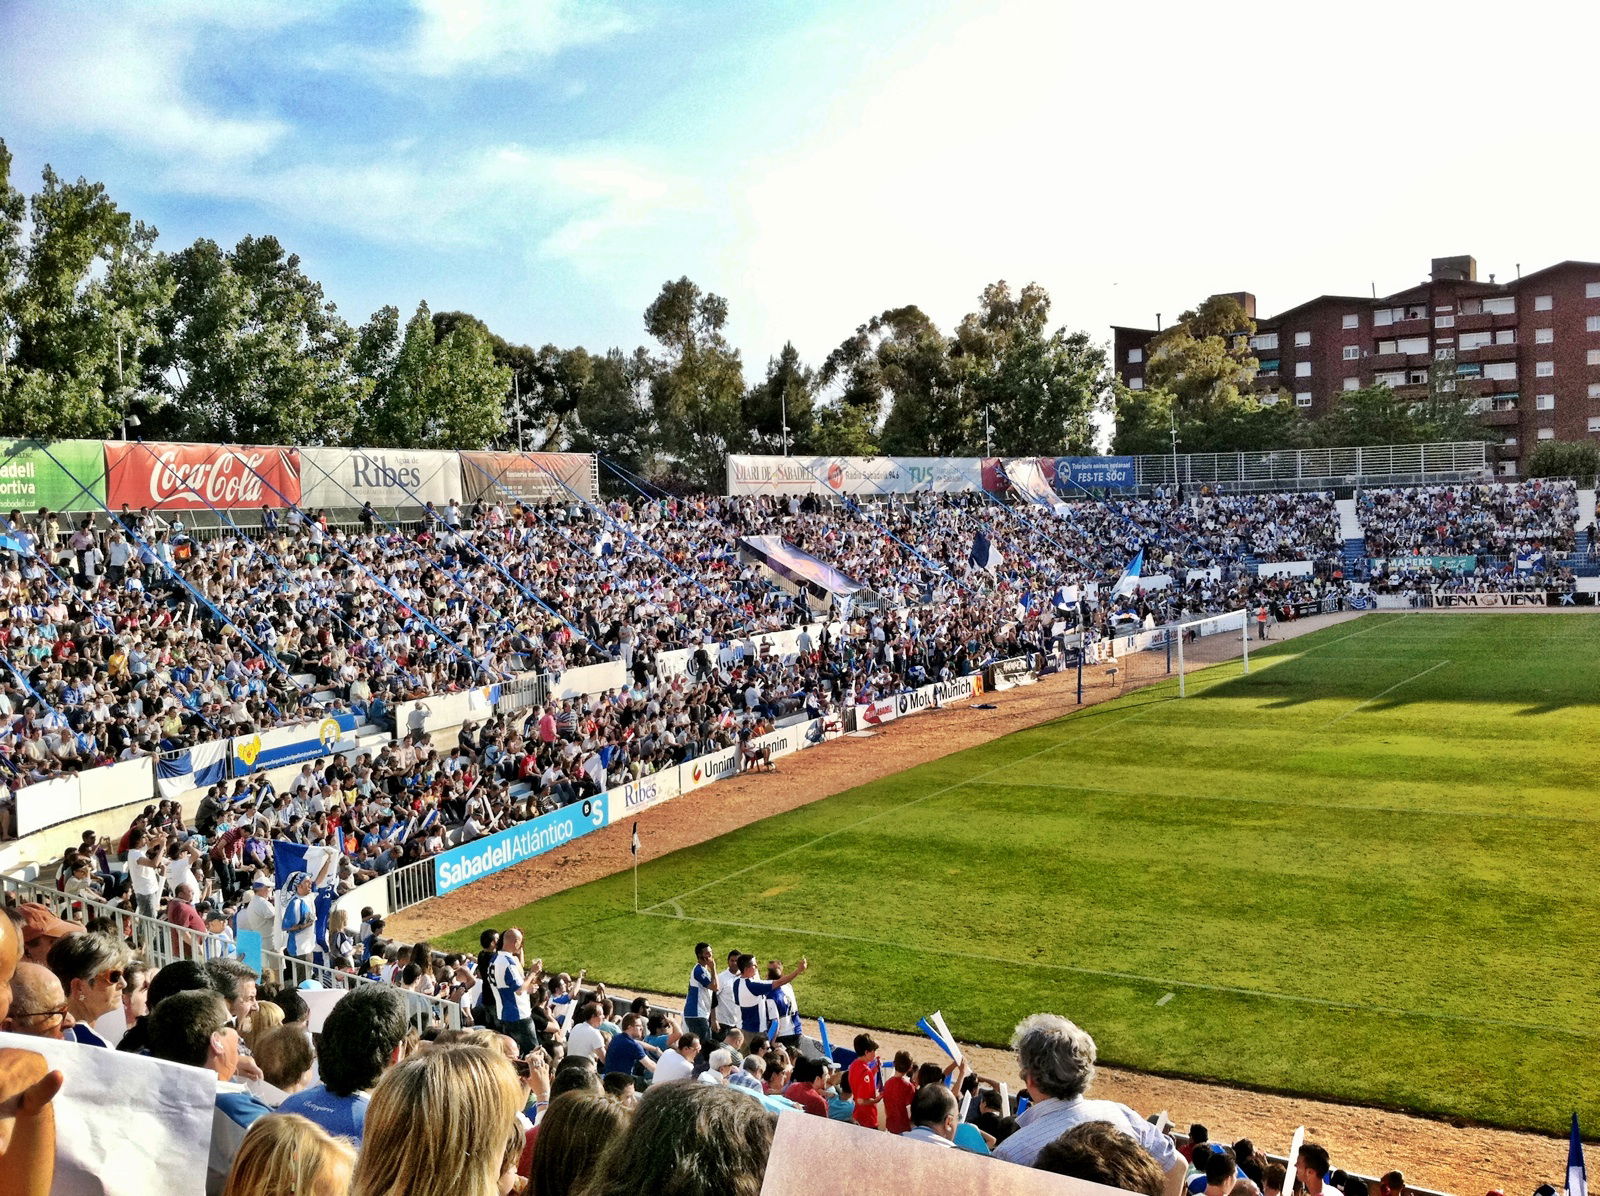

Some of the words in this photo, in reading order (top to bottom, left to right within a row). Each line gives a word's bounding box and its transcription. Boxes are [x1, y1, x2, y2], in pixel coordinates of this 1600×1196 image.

[150, 451, 265, 503] Coca-Cola
[351, 455, 421, 488] Ribes
[761, 465, 771, 481] DE
[909, 466, 934, 484] TUS
[1077, 472, 1104, 482] FES-TE
[0, 479, 36, 495] ortiva
[1435, 594, 1478, 607] VIENA
[1500, 592, 1546, 606] VIENA
[704, 754, 735, 778] Unnim
[624, 781, 657, 808] Ribes
[591, 799, 604, 826] S
